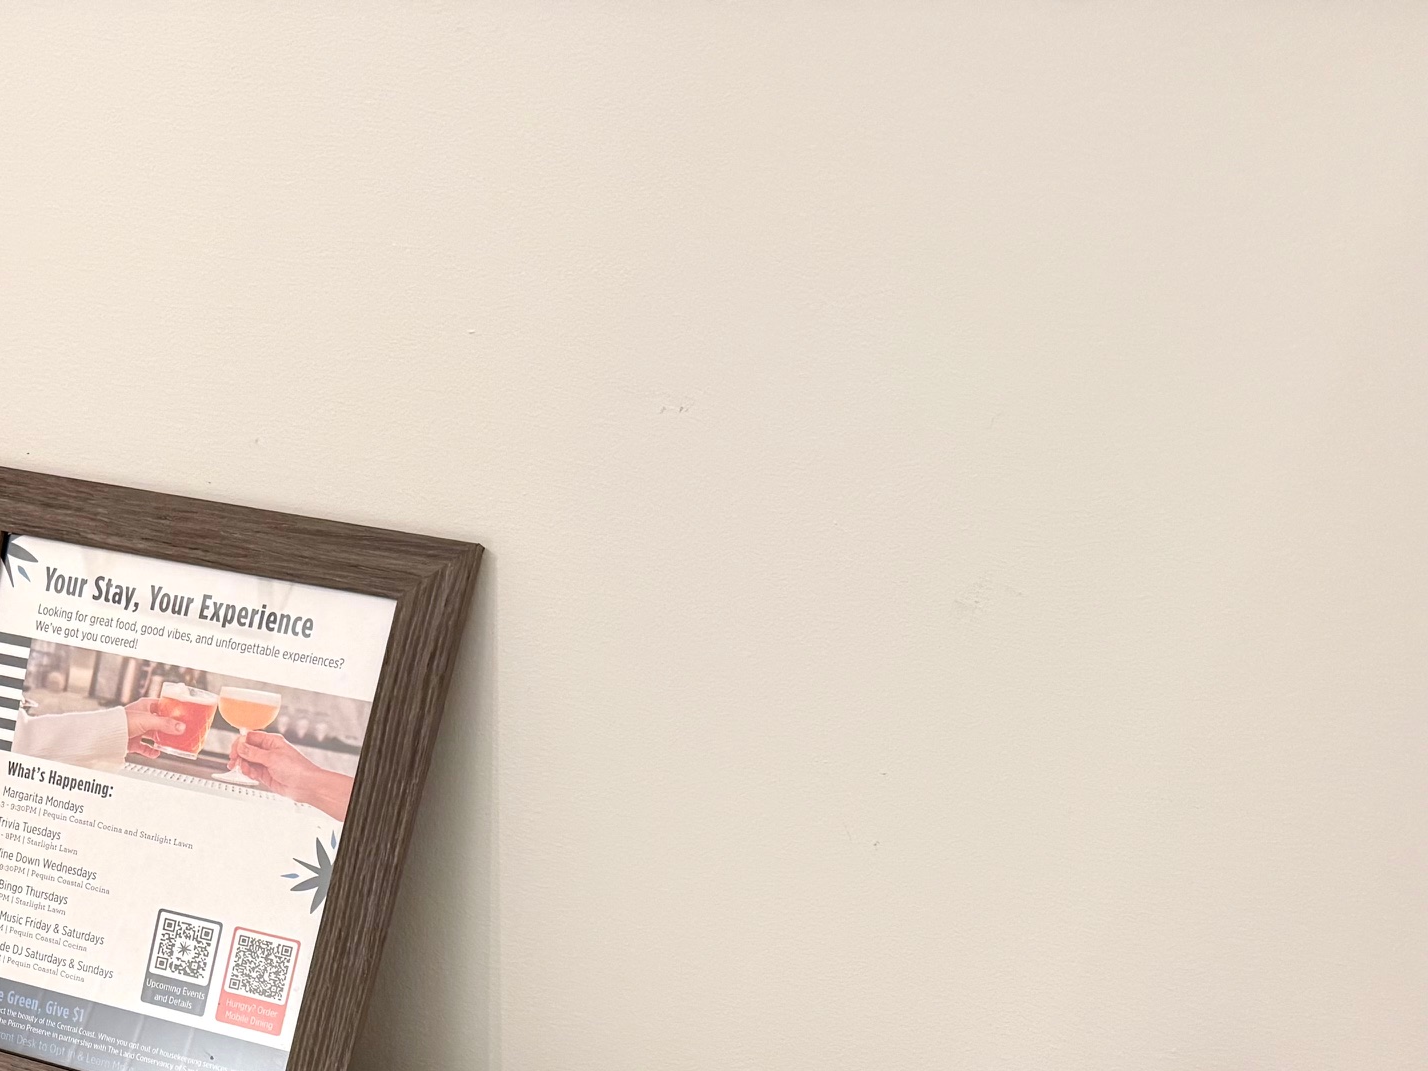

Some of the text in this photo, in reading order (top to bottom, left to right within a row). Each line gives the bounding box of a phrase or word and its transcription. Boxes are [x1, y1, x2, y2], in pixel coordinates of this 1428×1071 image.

[45, 566, 314, 639] Your Stay, Your Experience
[35, 620, 139, 649] We've got you covered!
[37, 603, 345, 669] Looking for great food, good vibes, and unforgettable experiences?
[8, 760, 114, 799] What's Happening:
[2, 785, 85, 814] Margarita Mondays
[22, 821, 62, 841] Tuesdays
[42, 808, 68, 822] Pequin
[68, 815, 96, 828] Coastal
[96, 821, 123, 834] Cocina
[123, 828, 139, 837] and
[139, 830, 172, 845] Starlight
[173, 838, 193, 850] Lawn
[26, 836, 58, 851] Starlight
[58, 844, 78, 856] Lawn
[15, 851, 41, 867] Down
[43, 858, 98, 881] Wednesdays
[30, 869, 56, 882] Pequin
[56, 875, 84, 889] Coastal
[84, 882, 110, 895] Cocina
[15, 896, 46, 911] Starlight
[46, 904, 66, 916] Lawn
[25, 885, 69, 906] Thursdays
[9, 926, 34, 939] Pequin
[34, 932, 62, 946] Coastal
[62, 939, 87, 952] Cocina
[24, 916, 52, 934] Friday
[52, 923, 60, 934] &
[61, 925, 105, 946] Saturdays
[6, 956, 31, 969] Pequin
[32, 963, 59, 976] Coastal
[59, 969, 85, 983] Cocina
[12, 944, 24, 956] DJ
[24, 947, 67, 968] Saturdays
[68, 958, 75, 969] &
[76, 960, 114, 979] Sundays
[146, 978, 206, 1001] Upcoming Events
[153, 994, 193, 1010] and Details
[7, 990, 42, 1015] Green,
[45, 1000, 70, 1019] Give
[71, 1005, 86, 1023] $1
[225, 998, 279, 1018] Hungry? Order
[224, 1010, 274, 1031] Mobile Dining
[16, 1034, 36, 1049] Desk
[38, 1040, 47, 1052] to
[49, 1043, 66, 1057] Opt
